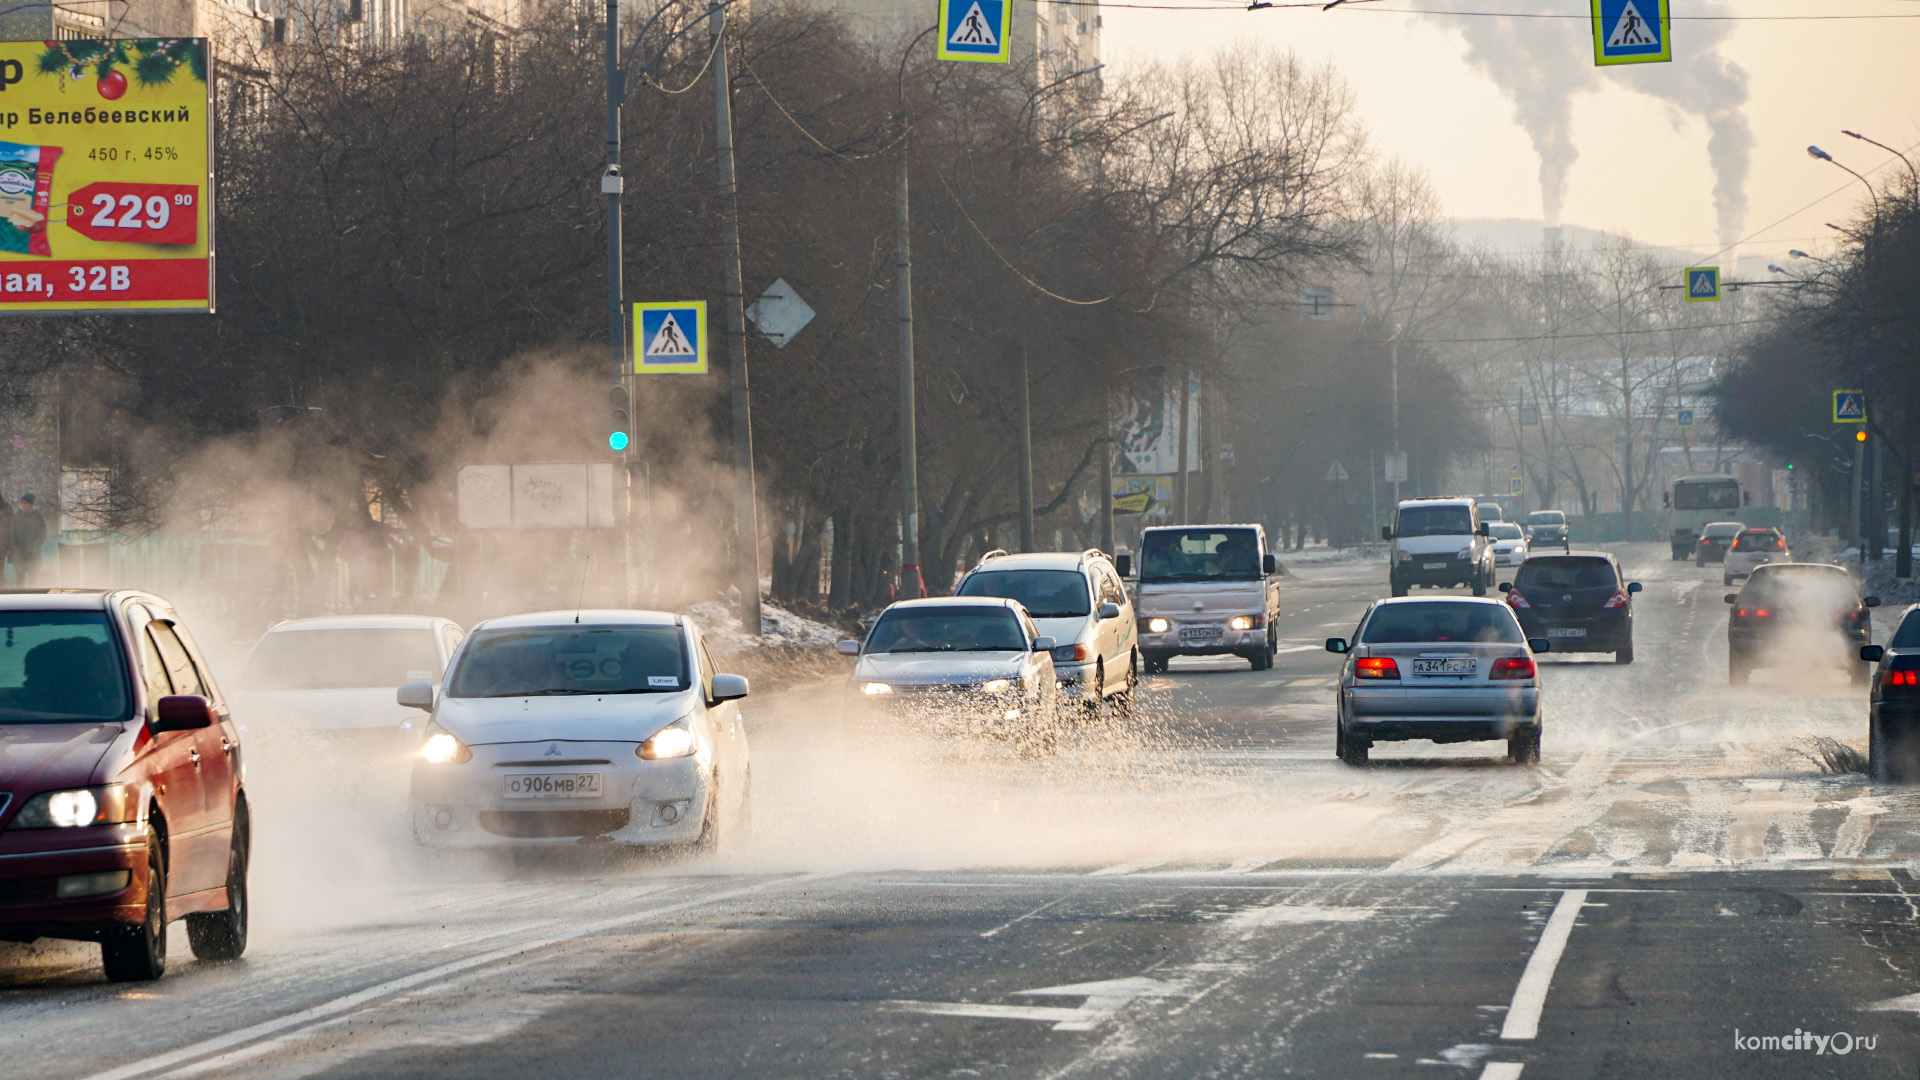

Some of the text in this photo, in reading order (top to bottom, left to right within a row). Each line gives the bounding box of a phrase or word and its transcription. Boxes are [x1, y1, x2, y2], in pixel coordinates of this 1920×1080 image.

[29, 105, 190, 125] Белебеевский
[88, 146, 178, 162] 450 г, 45%
[90, 193, 193, 230] 229 90
[0, 273, 54, 298] ая,
